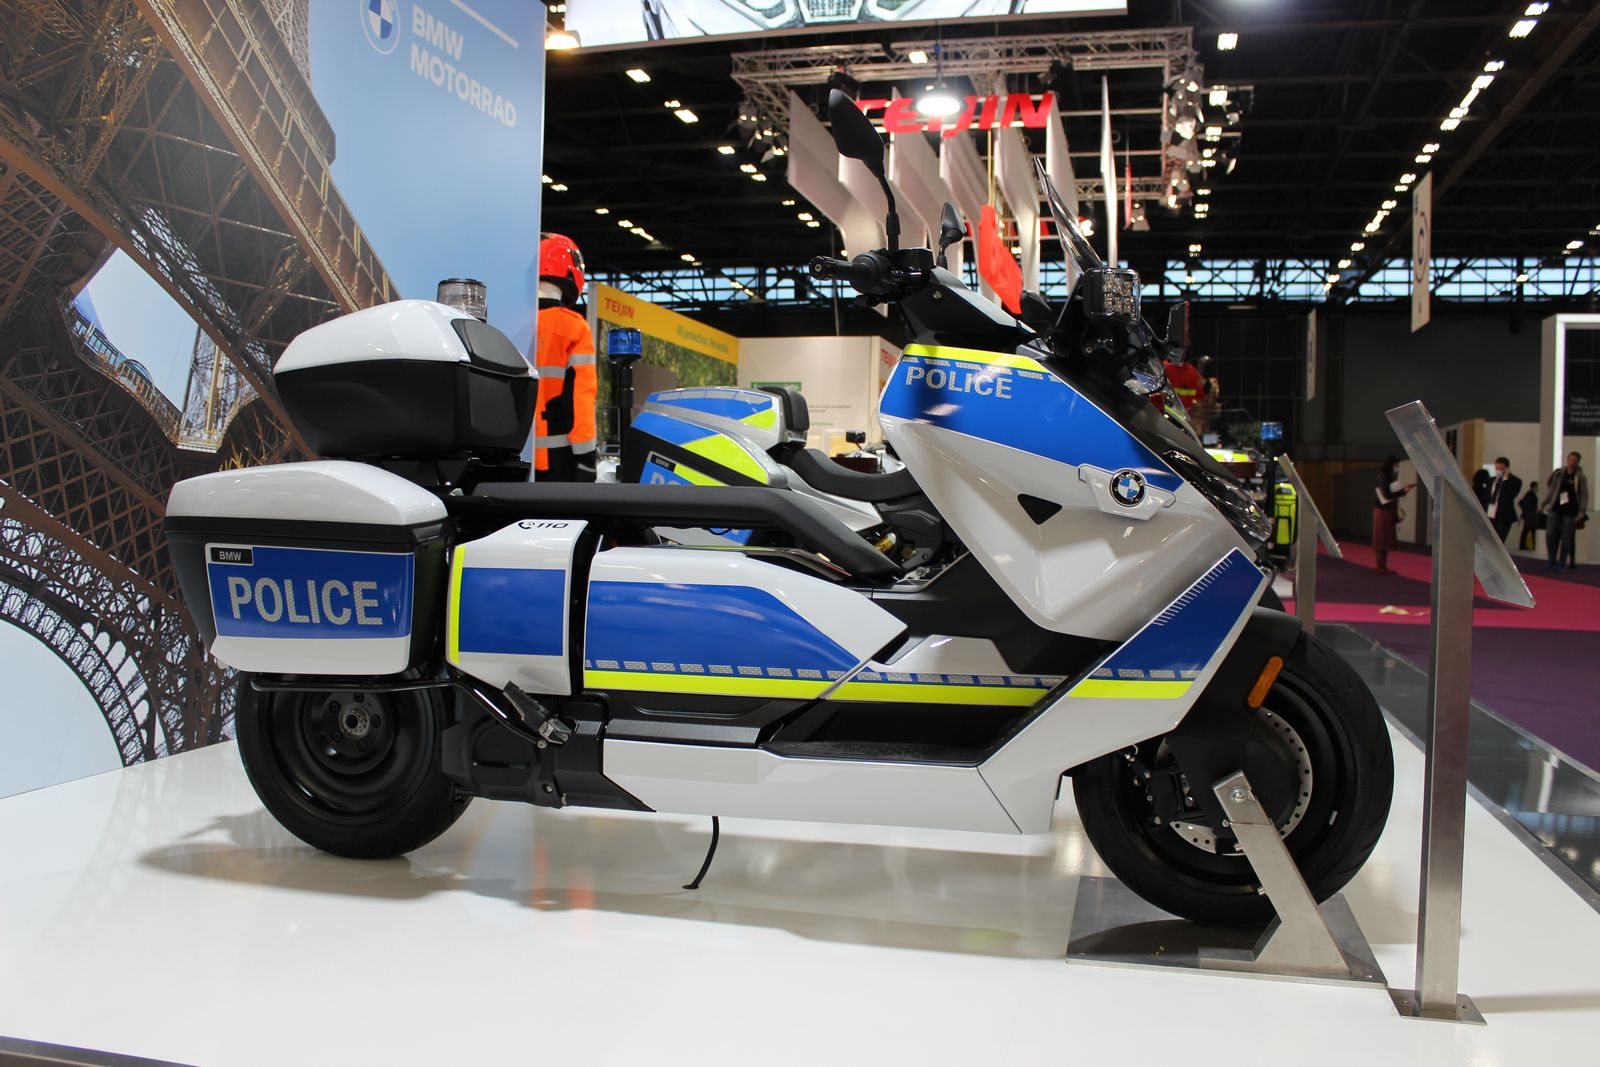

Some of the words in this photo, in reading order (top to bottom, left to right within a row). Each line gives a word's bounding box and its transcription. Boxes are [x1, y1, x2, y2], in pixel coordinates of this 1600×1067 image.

[413, 4, 464, 60] BMW
[410, 42, 516, 127] MOTORRAD
[604, 297, 635, 319] TEIJIN
[906, 366, 1012, 399] POLICE
[219, 551, 242, 561] BMW
[228, 577, 383, 626] POLICE
